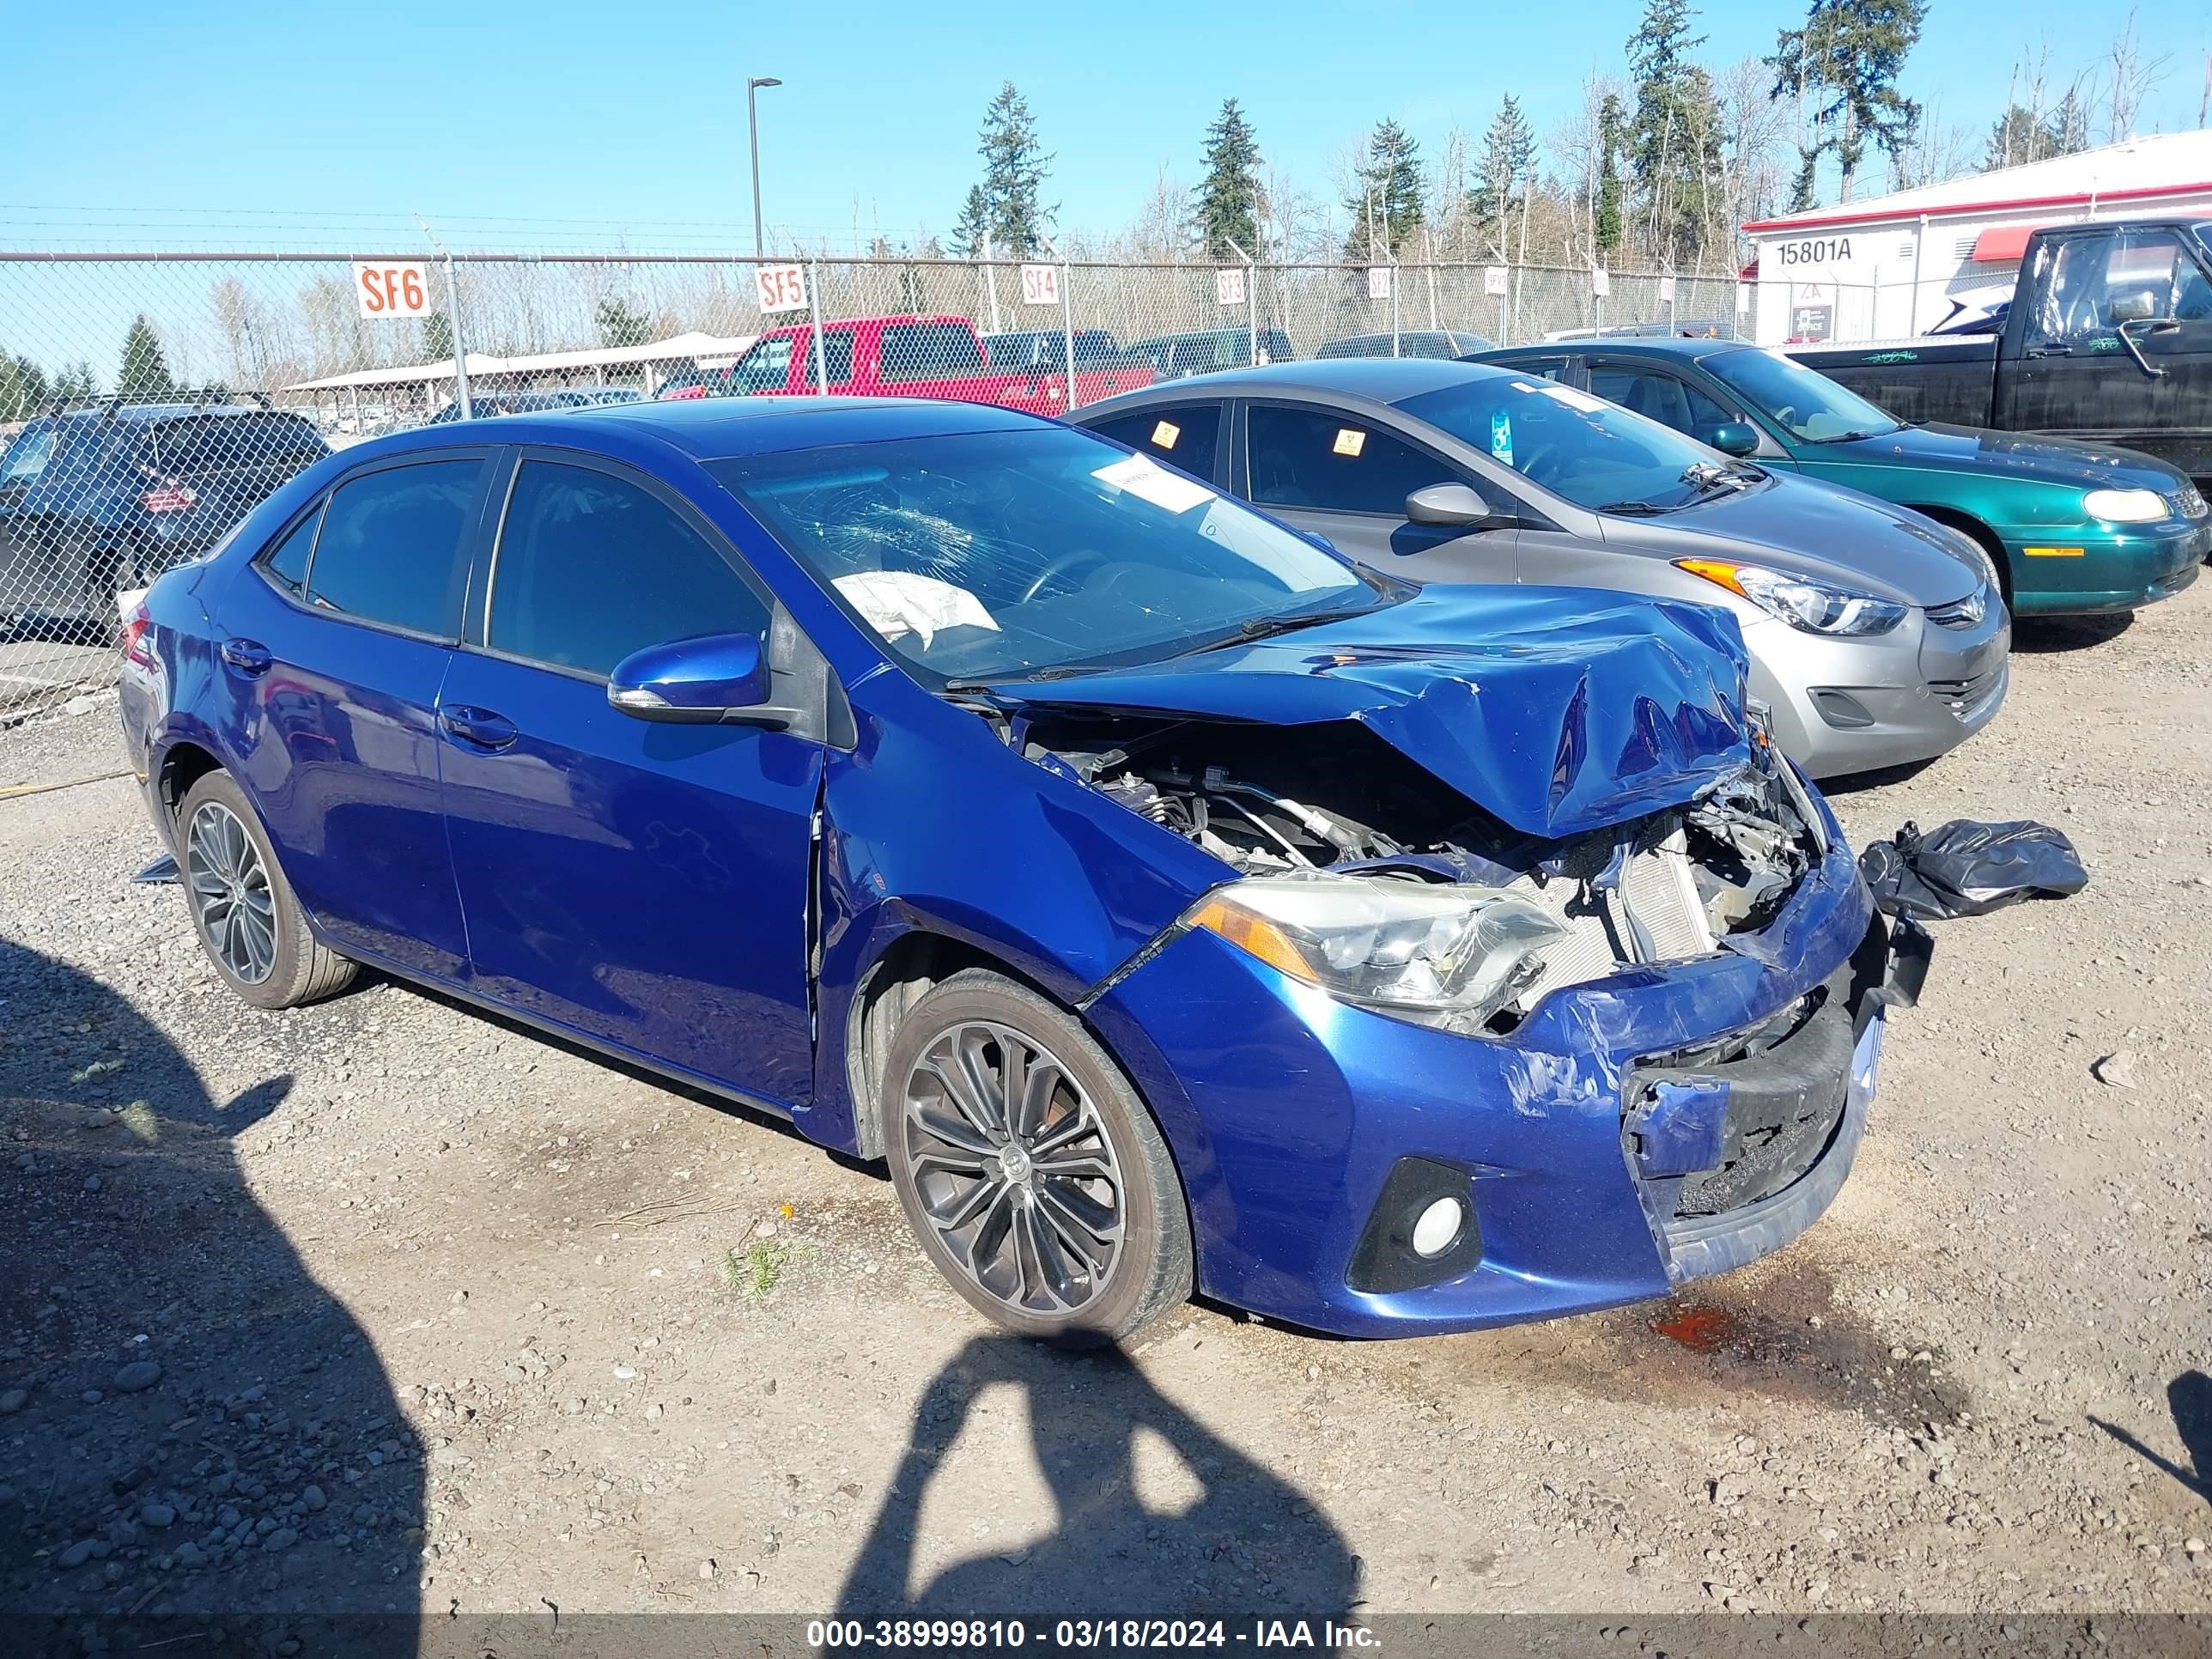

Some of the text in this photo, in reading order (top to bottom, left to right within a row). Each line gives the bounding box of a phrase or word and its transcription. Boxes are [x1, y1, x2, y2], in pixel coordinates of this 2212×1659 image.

[1777, 239, 1851, 265] 15801A
[362, 269, 423, 312] SF6
[760, 270, 802, 307] SF5
[1025, 270, 1054, 299] SF4
[1220, 274, 1242, 300] SF3
[1371, 272, 1388, 294] SF2
